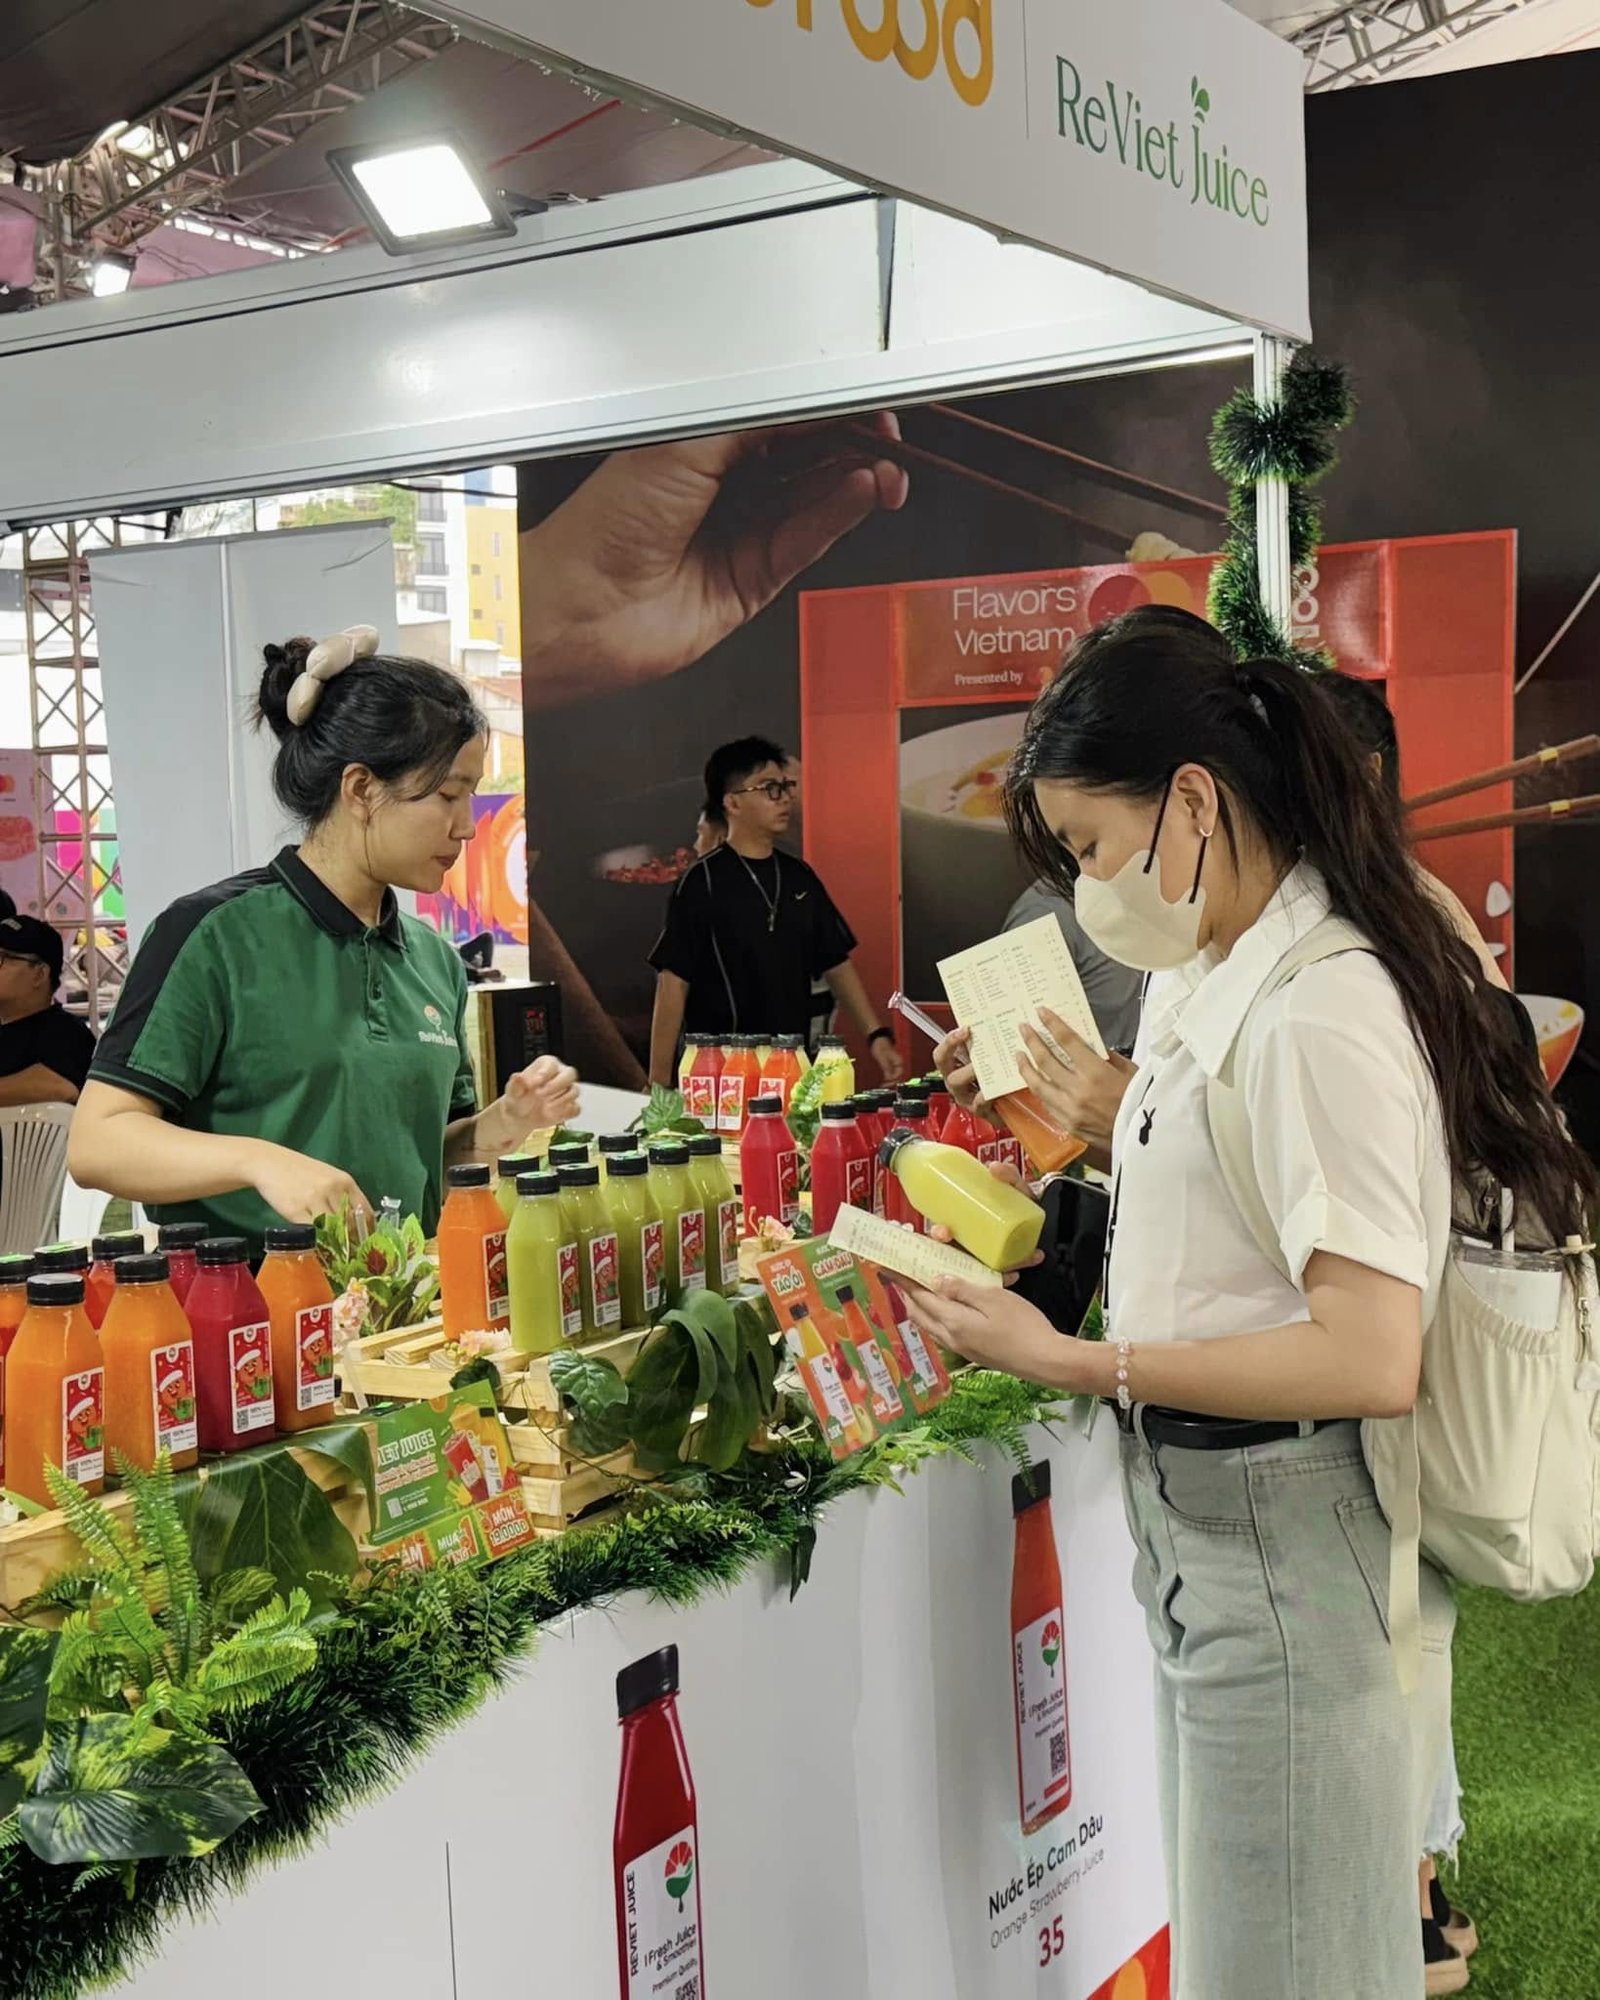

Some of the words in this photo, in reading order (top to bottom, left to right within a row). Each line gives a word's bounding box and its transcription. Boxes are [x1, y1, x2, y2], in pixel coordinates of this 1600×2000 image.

[1056, 54, 1184, 189] ReViet
[1190, 104, 1269, 227] Juice
[953, 586, 1077, 621] Flavors
[954, 625, 1076, 656] Vietnam
[954, 671, 1008, 686] Presented
[1010, 670, 1024, 684] by
[988, 1876, 1024, 1920] Nước
[1026, 1856, 1044, 1890] Ép
[1047, 1836, 1076, 1871] Cam
[1079, 1814, 1103, 1847] Dâu
[626, 1870, 637, 1915] JUICE
[990, 1911, 1028, 1949] Orange
[1029, 1867, 1081, 1919] Strawberry
[1081, 1848, 1105, 1876] Juice
[628, 1921, 639, 1977] REVIET
[674, 1923, 697, 1947] Juice
[1039, 1914, 1065, 1967] 35
